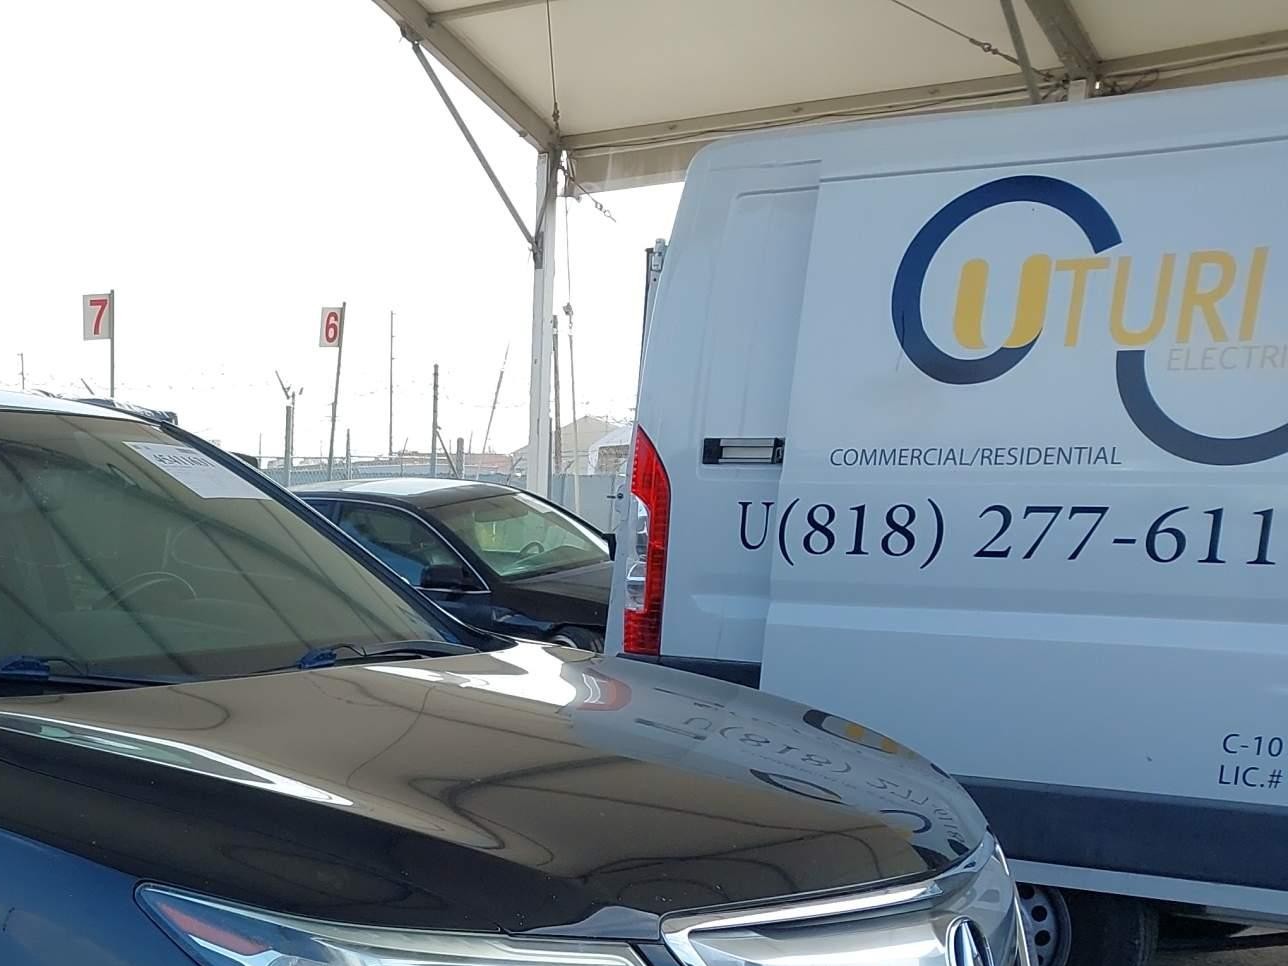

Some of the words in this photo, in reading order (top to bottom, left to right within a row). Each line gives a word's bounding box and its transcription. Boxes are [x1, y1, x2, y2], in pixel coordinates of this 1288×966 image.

[89, 298, 108, 336] 7
[325, 311, 339, 343] 6
[829, 446, 1122, 467] COMMERCIAL/RESIDENTIAL
[972, 504, 1278, 566] 277-611
[1222, 733, 1284, 758] C-10
[1218, 764, 1284, 789] LIC.#
